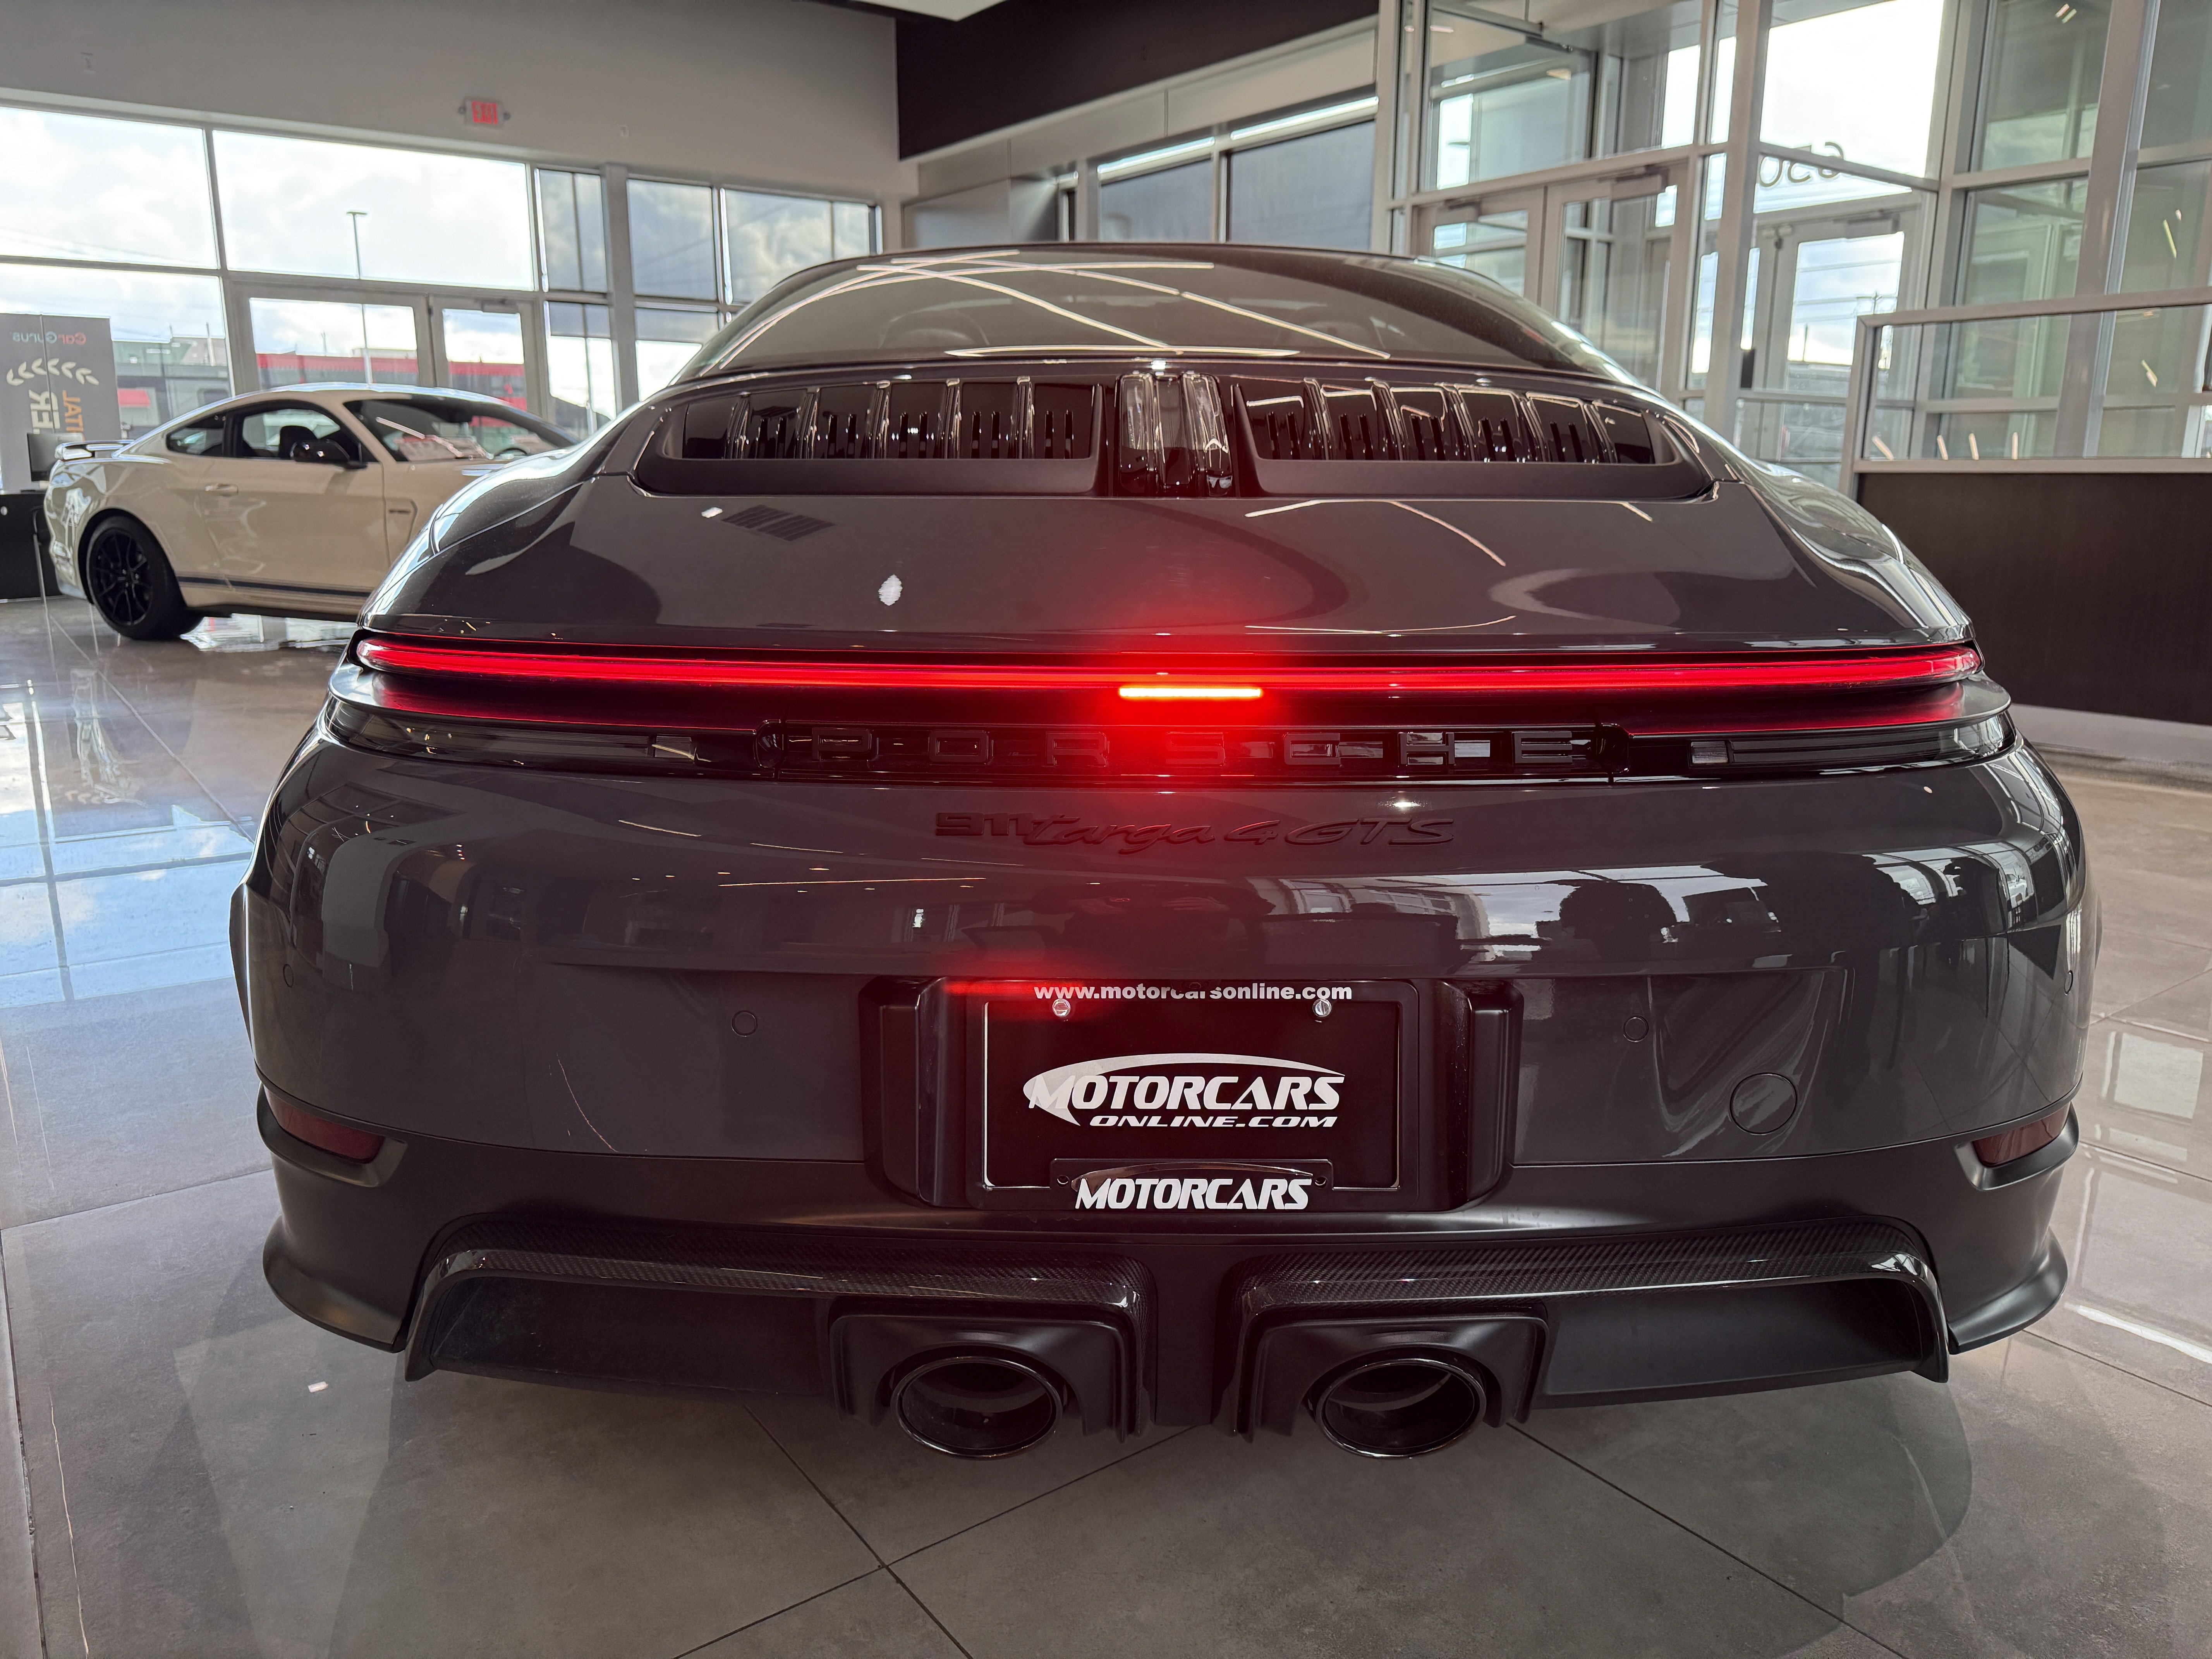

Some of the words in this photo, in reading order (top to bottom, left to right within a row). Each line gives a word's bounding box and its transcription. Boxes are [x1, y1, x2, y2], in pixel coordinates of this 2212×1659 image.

[812, 727, 1572, 767] PORSCHE
[936, 812, 1035, 836] 911
[1224, 819, 1280, 846] 4
[1285, 818, 1454, 845] GTS
[1029, 1075, 1345, 1110] MOTORCARS
[1089, 1116, 1338, 1127] ONLINE.COM
[1075, 1178, 1312, 1209] MOTORCARS
